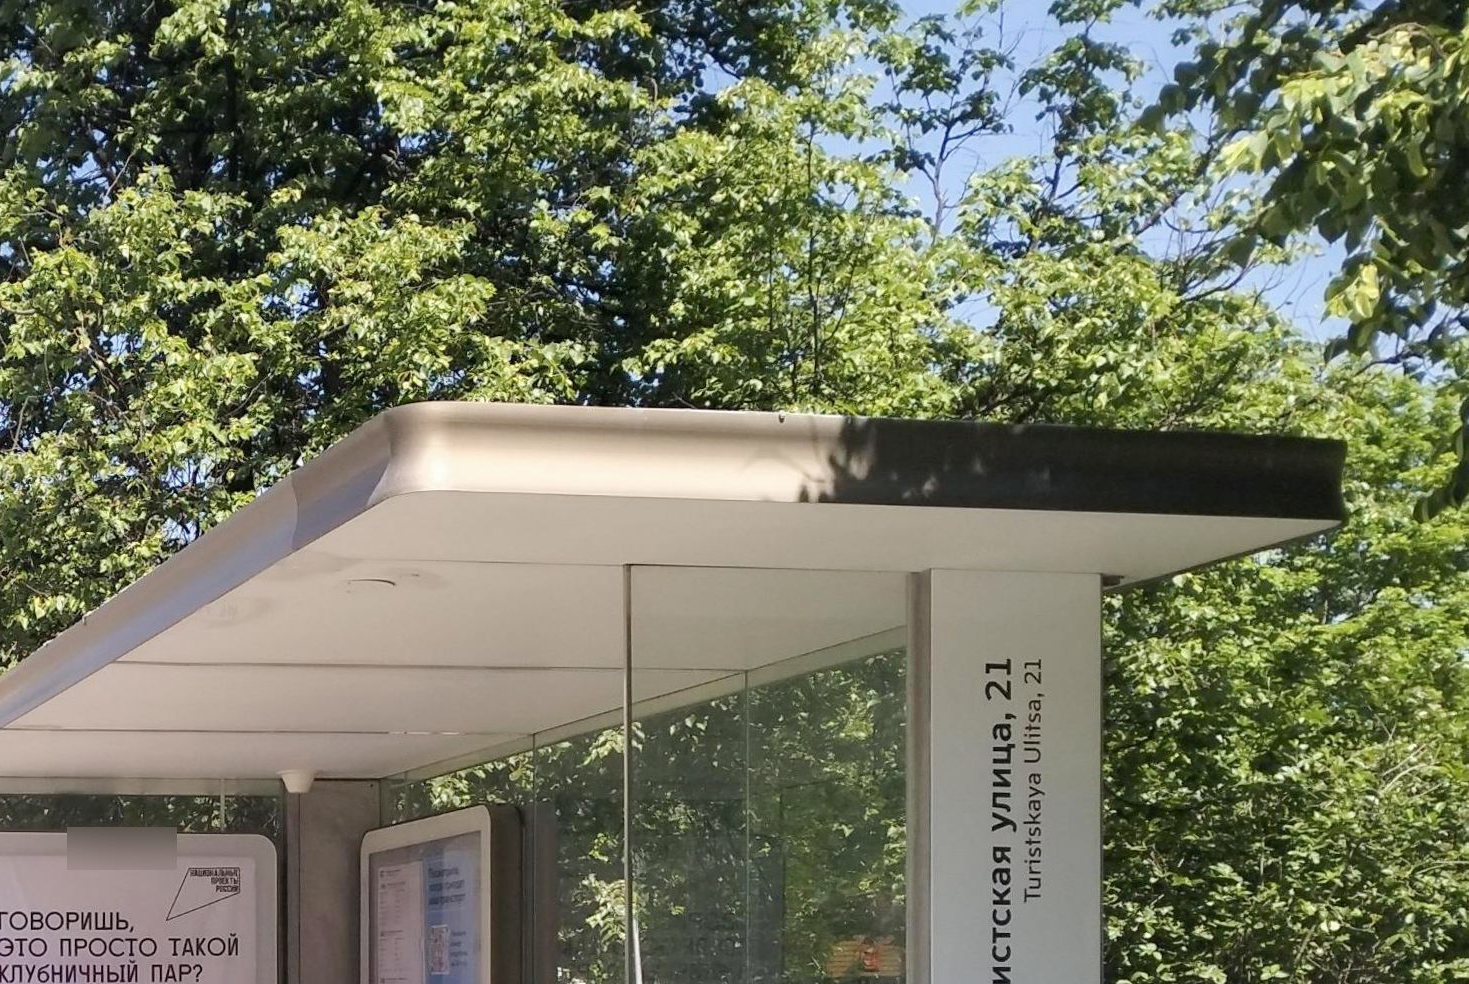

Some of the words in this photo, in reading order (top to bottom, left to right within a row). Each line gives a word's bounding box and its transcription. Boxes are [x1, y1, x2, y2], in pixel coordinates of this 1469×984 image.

[984, 658, 1012, 701] 21
[1023, 658, 1043, 685] 21
[1022, 692, 1046, 764] Ulitsa,
[991, 713, 1018, 833] улица,
[1023, 772, 1046, 904] Turistskaya
[59, 937, 158, 957] ПРОСТО
[168, 933, 240, 957] ТАКОЙ
[150, 964, 204, 984] ПАР?
